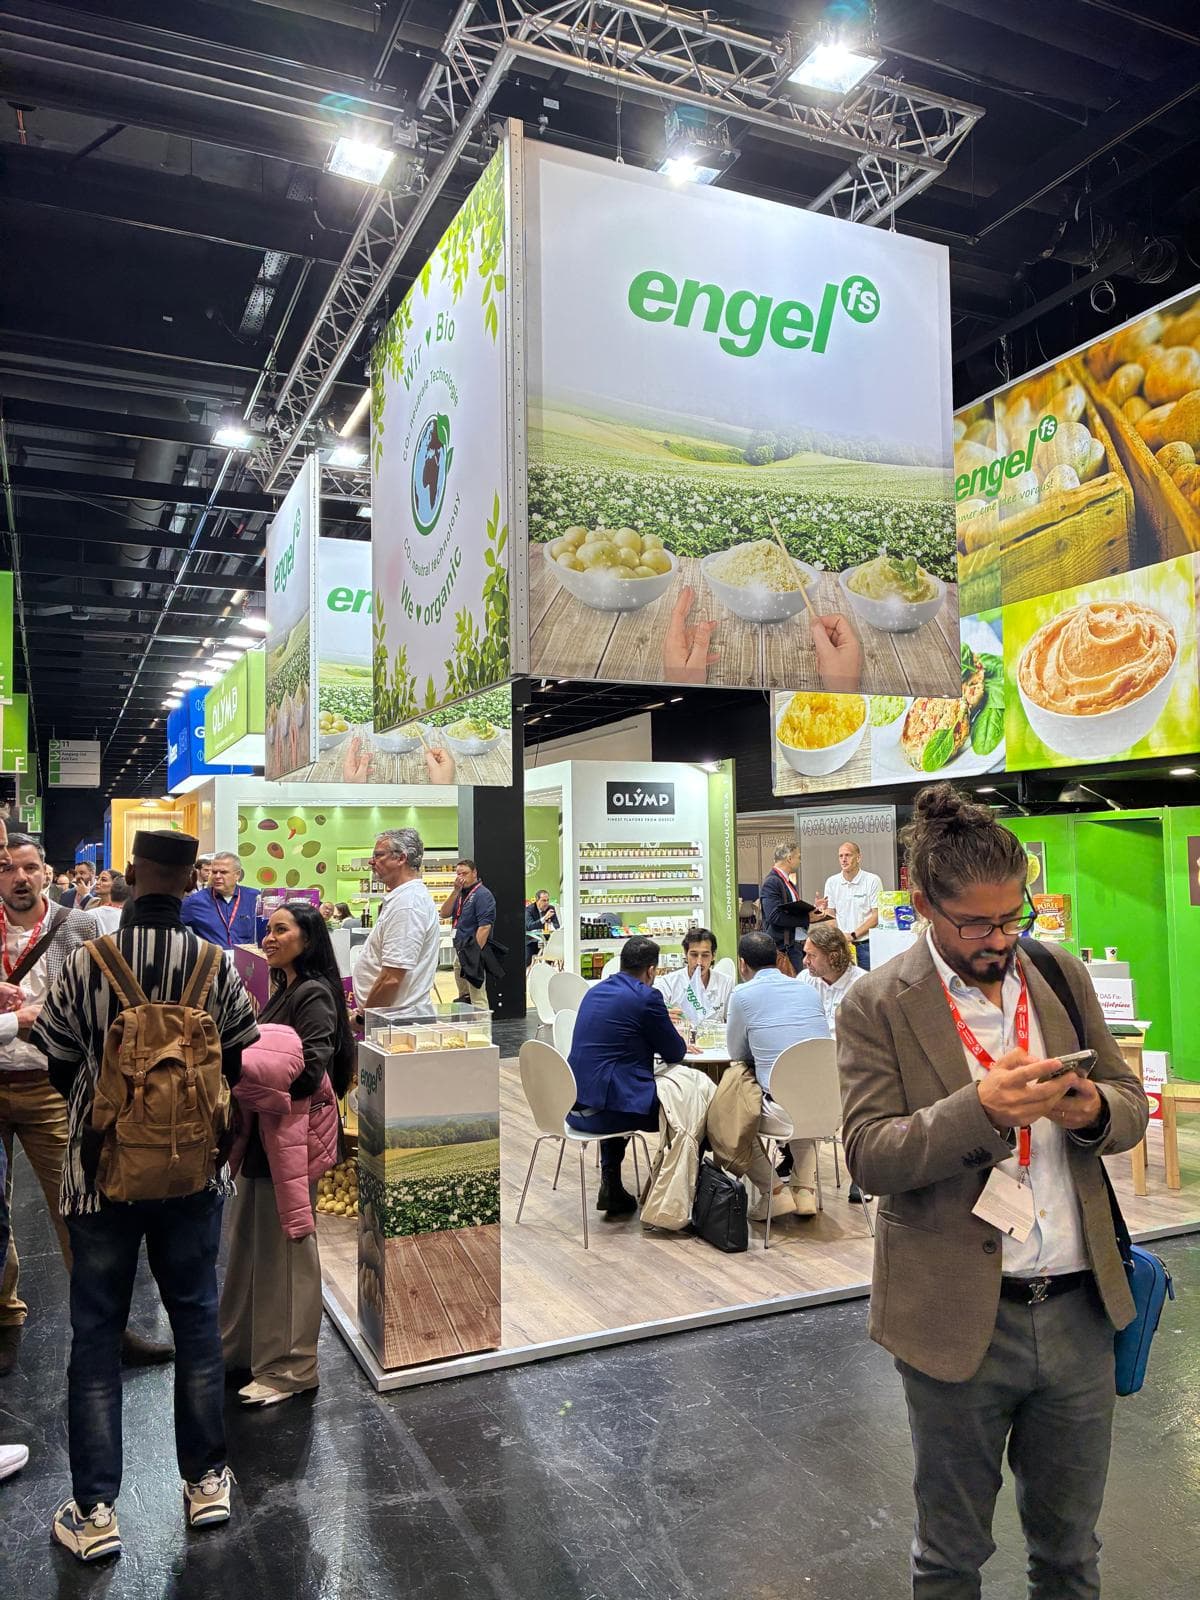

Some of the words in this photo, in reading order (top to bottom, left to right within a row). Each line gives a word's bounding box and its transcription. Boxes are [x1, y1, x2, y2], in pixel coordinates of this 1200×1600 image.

[404, 344, 421, 391] Wir
[436, 310, 455, 341] Bio
[628, 270, 839, 358] engel
[430, 367, 458, 407] Technologie
[955, 428, 1037, 501] engel
[412, 561, 431, 576] neutral
[431, 492, 460, 572] technology
[401, 579, 413, 619] We
[424, 546, 462, 626] organic
[15, 757, 25, 771] F
[25, 794, 36, 806] G
[724, 812, 732, 920] KONSTANTOPOULOS
